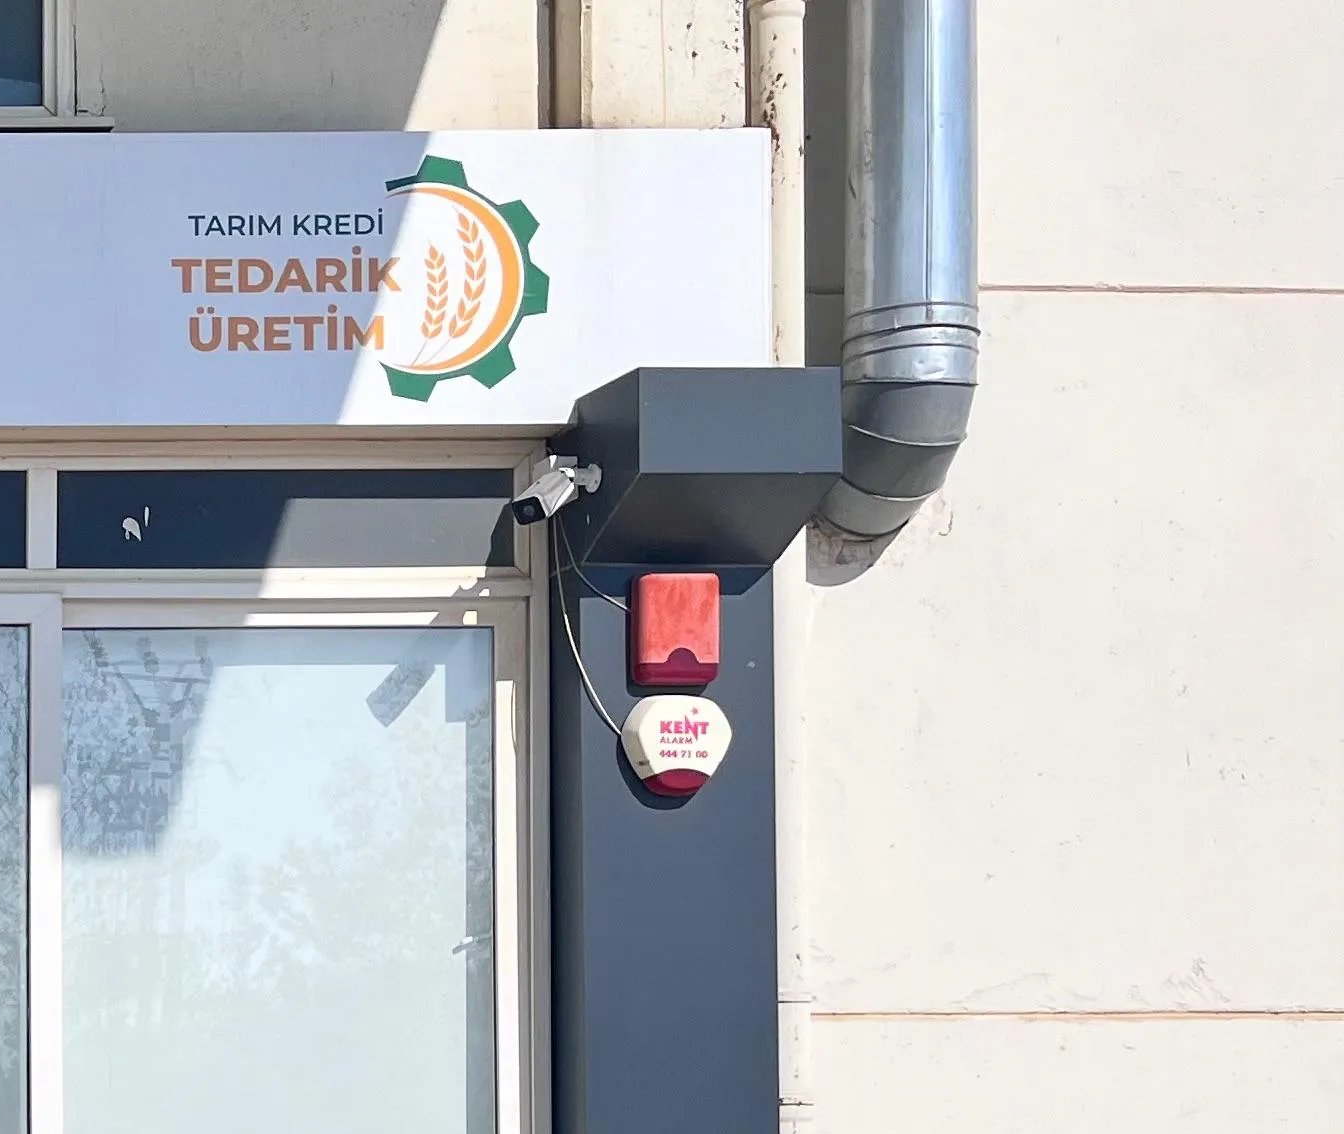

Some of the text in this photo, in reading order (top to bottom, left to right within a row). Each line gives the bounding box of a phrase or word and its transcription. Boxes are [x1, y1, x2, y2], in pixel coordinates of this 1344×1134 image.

[188, 207, 384, 236] TARIM KREDİ
[171, 245, 402, 294] TEDARİK
[188, 303, 385, 352] ÜRETİM
[660, 715, 709, 741] KENT
